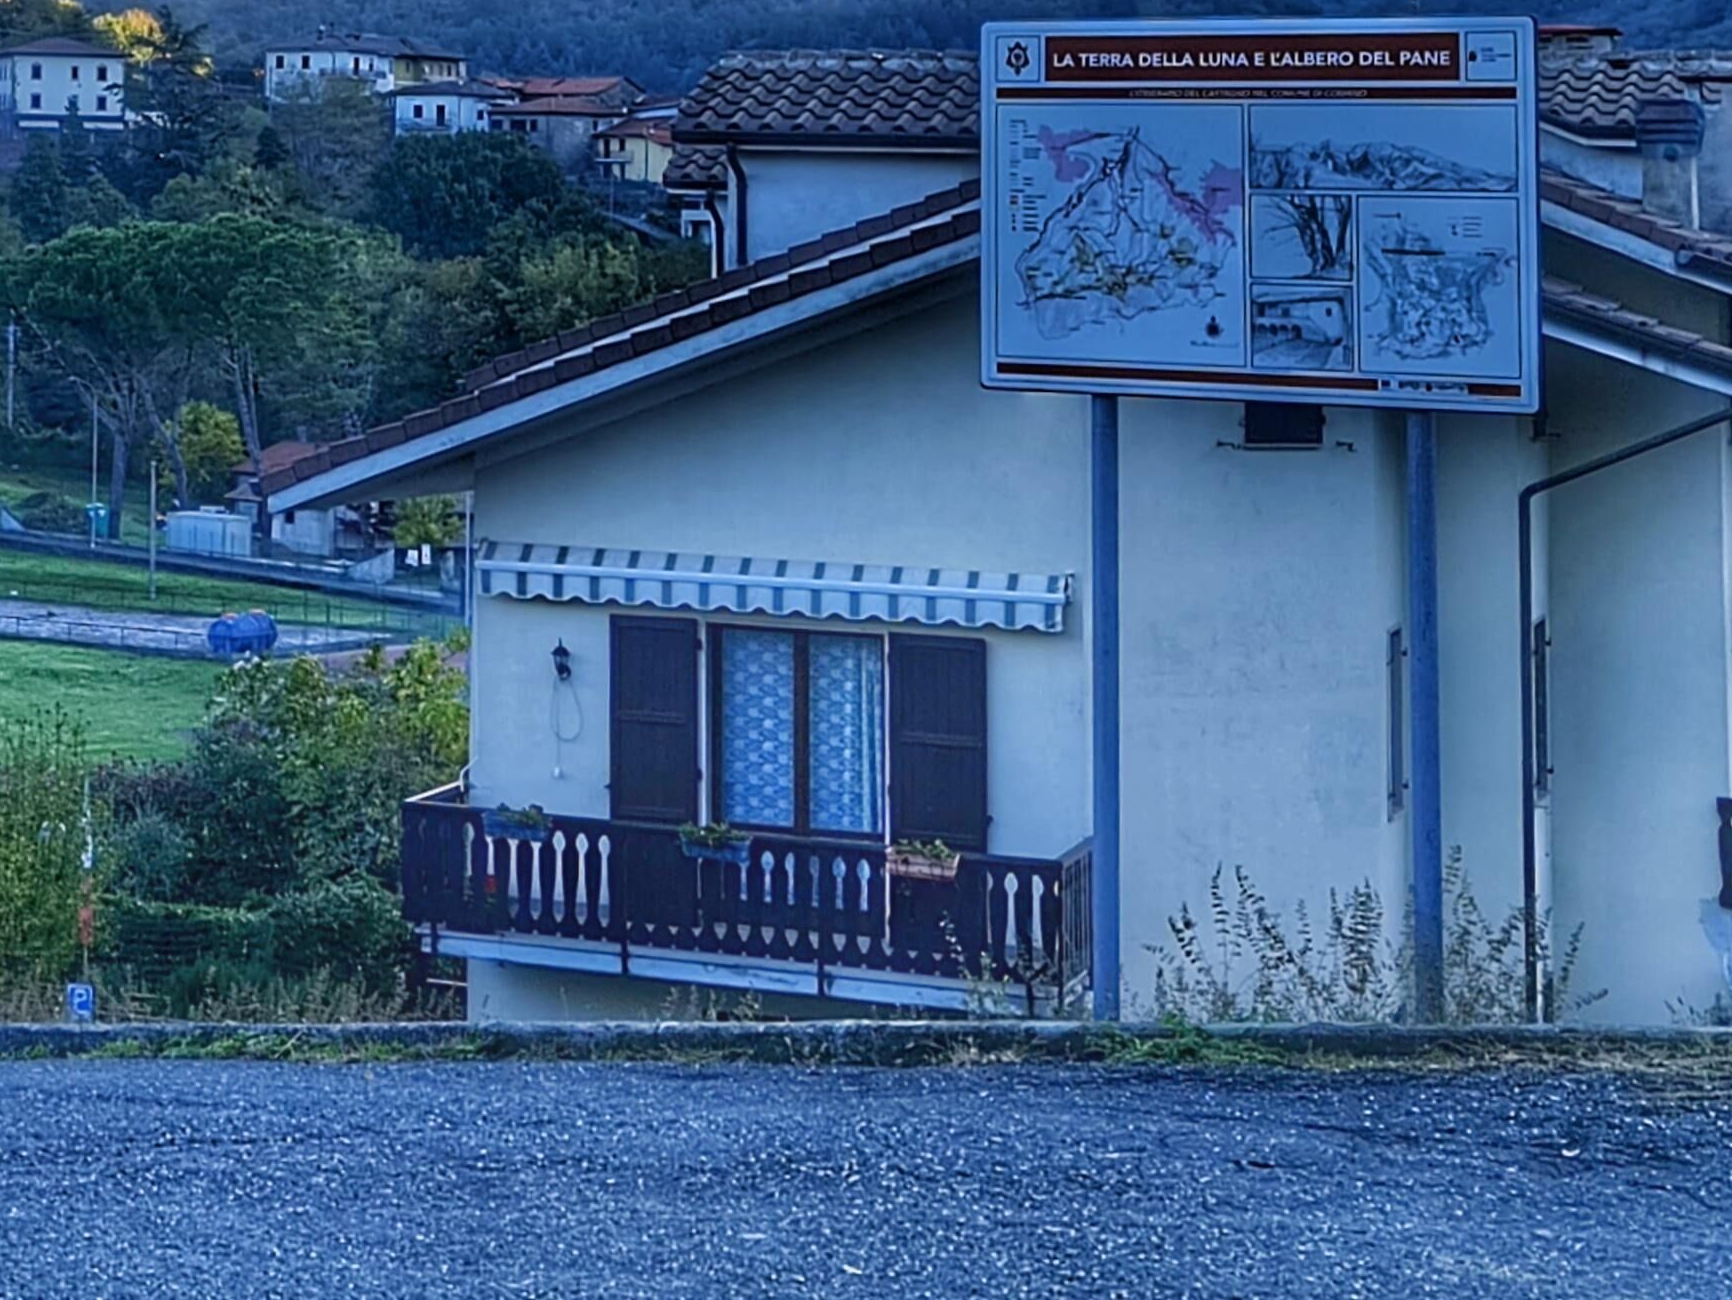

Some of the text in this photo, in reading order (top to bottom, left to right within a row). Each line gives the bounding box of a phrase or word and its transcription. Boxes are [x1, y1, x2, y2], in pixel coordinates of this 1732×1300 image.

[1053, 50, 1451, 68] LA TERRA DELLA LUNA E L'ALBERO DEL PANE
[73, 989, 89, 1014] P
